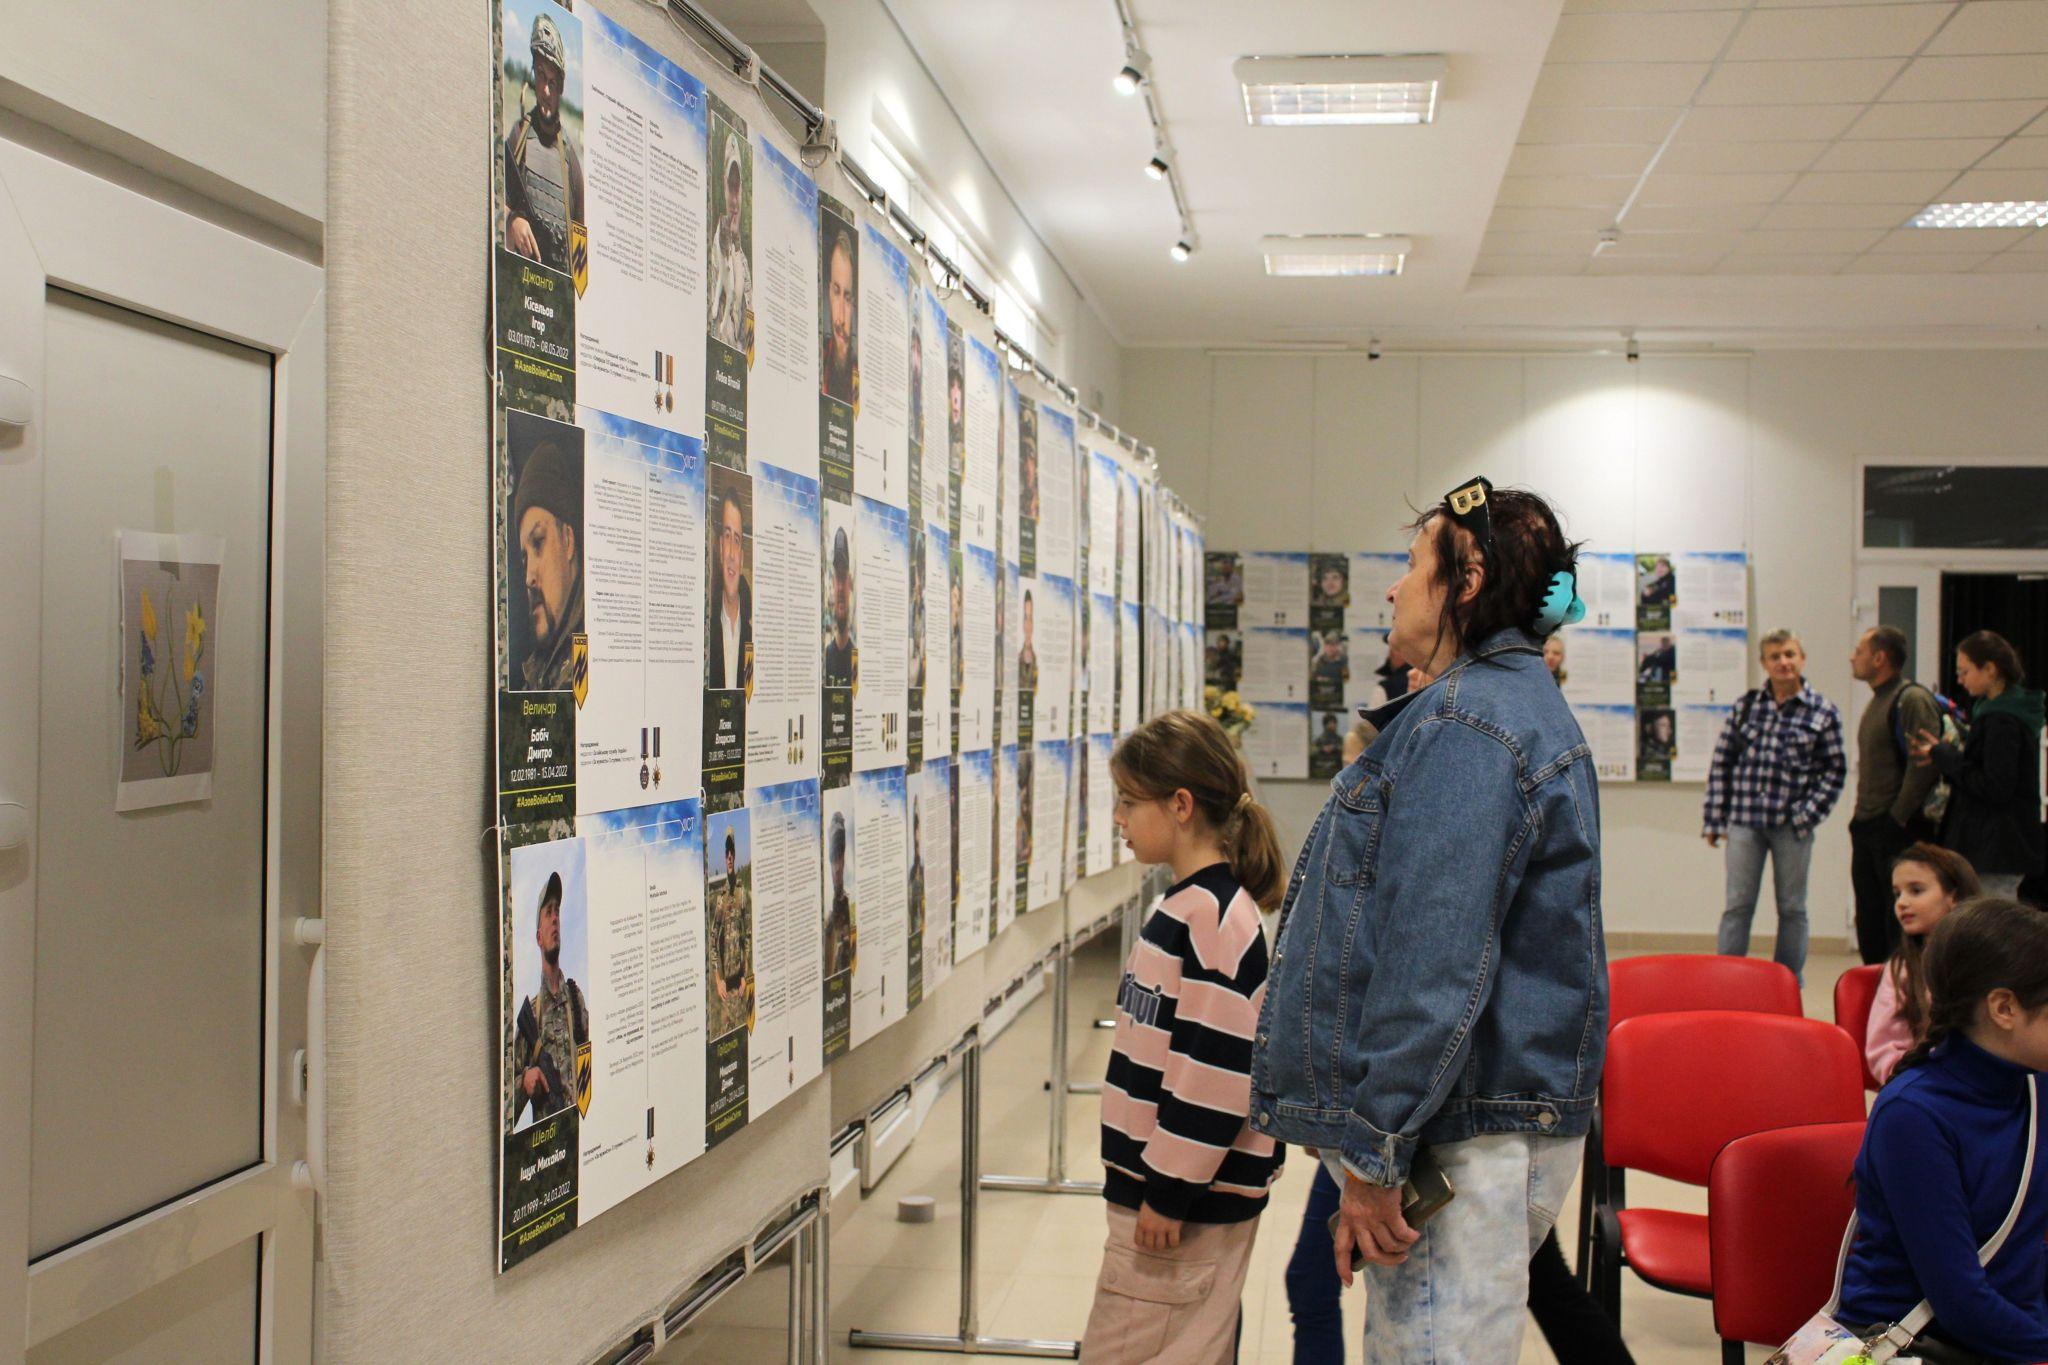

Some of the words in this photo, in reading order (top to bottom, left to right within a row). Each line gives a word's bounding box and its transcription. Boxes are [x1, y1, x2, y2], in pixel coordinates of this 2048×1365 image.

[521, 266, 554, 291] Джанго
[524, 295, 554, 319] Кісельов
[531, 316, 546, 336] Ігор
[508, 329, 536, 350] 03.01.1975
[541, 339, 569, 360] 08.05.2022
[523, 700, 557, 720] Величар
[530, 728, 549, 743] Бабіч
[527, 746, 553, 764] Дмитро
[510, 767, 537, 783] 12.02.1981
[541, 764, 568, 781] 15.04.2022
[519, 1162, 537, 1182] Іщук
[537, 1149, 566, 1174] Михайло
[512, 1199, 539, 1224] 20.11.1999
[543, 1181, 571, 1205] 24.03.2022
